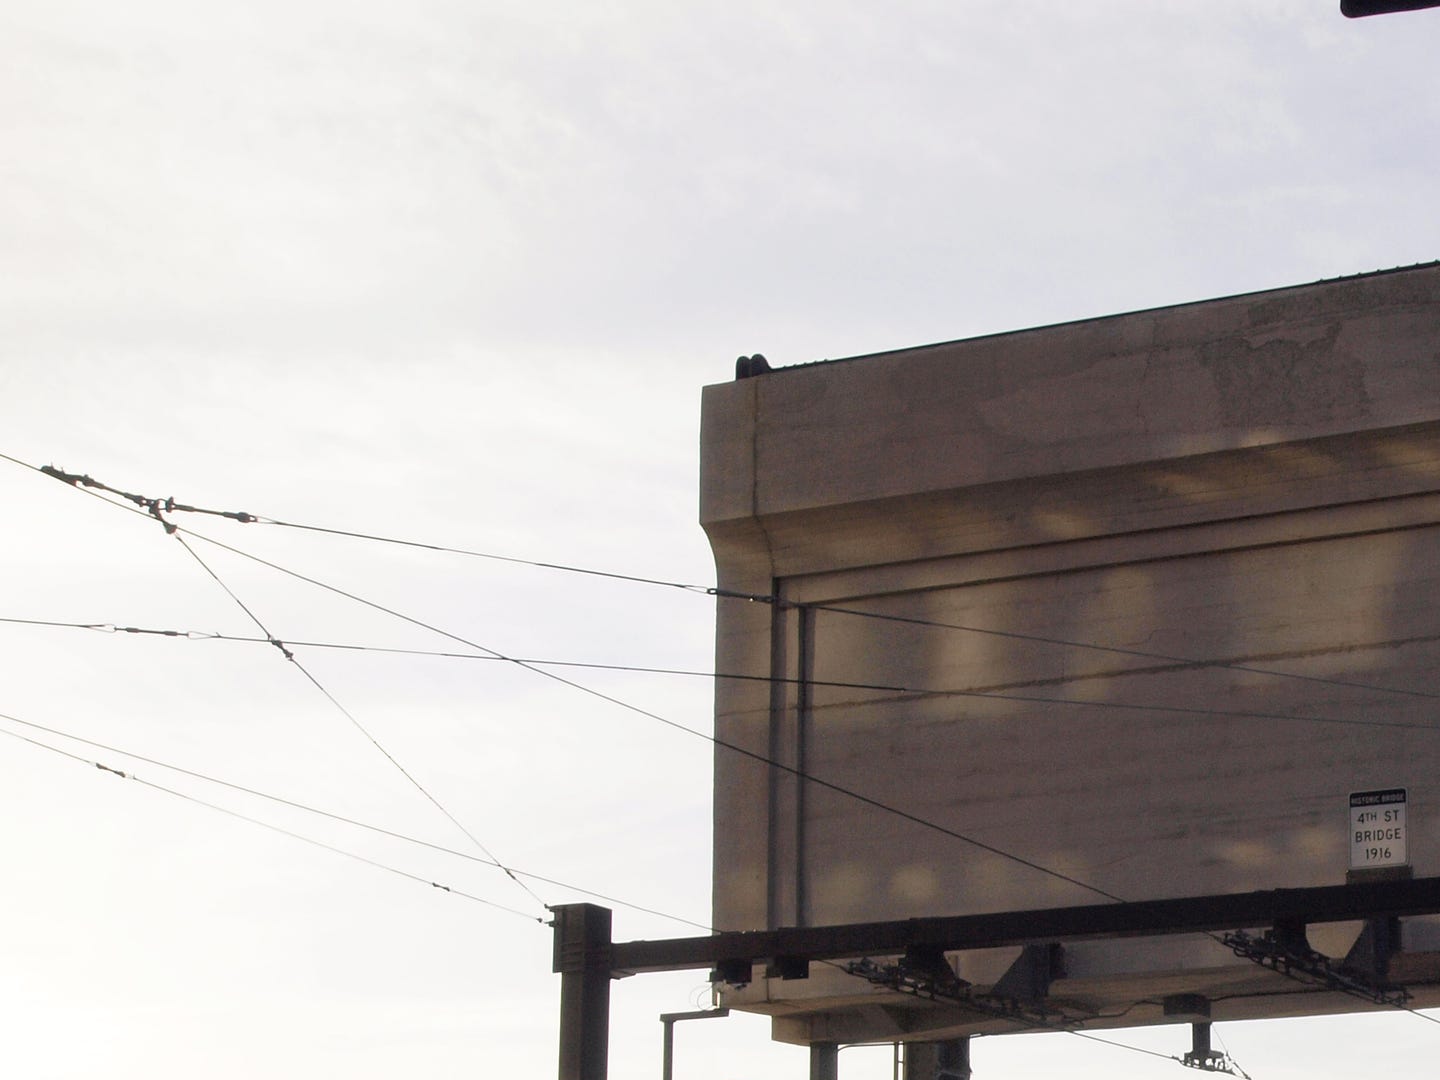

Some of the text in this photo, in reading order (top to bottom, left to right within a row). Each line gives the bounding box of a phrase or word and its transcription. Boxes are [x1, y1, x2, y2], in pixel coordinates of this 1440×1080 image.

[1357, 810, 1399, 824] 4TH ST
[1355, 828, 1401, 843] BRIDGE
[1365, 848, 1391, 860] 1916
